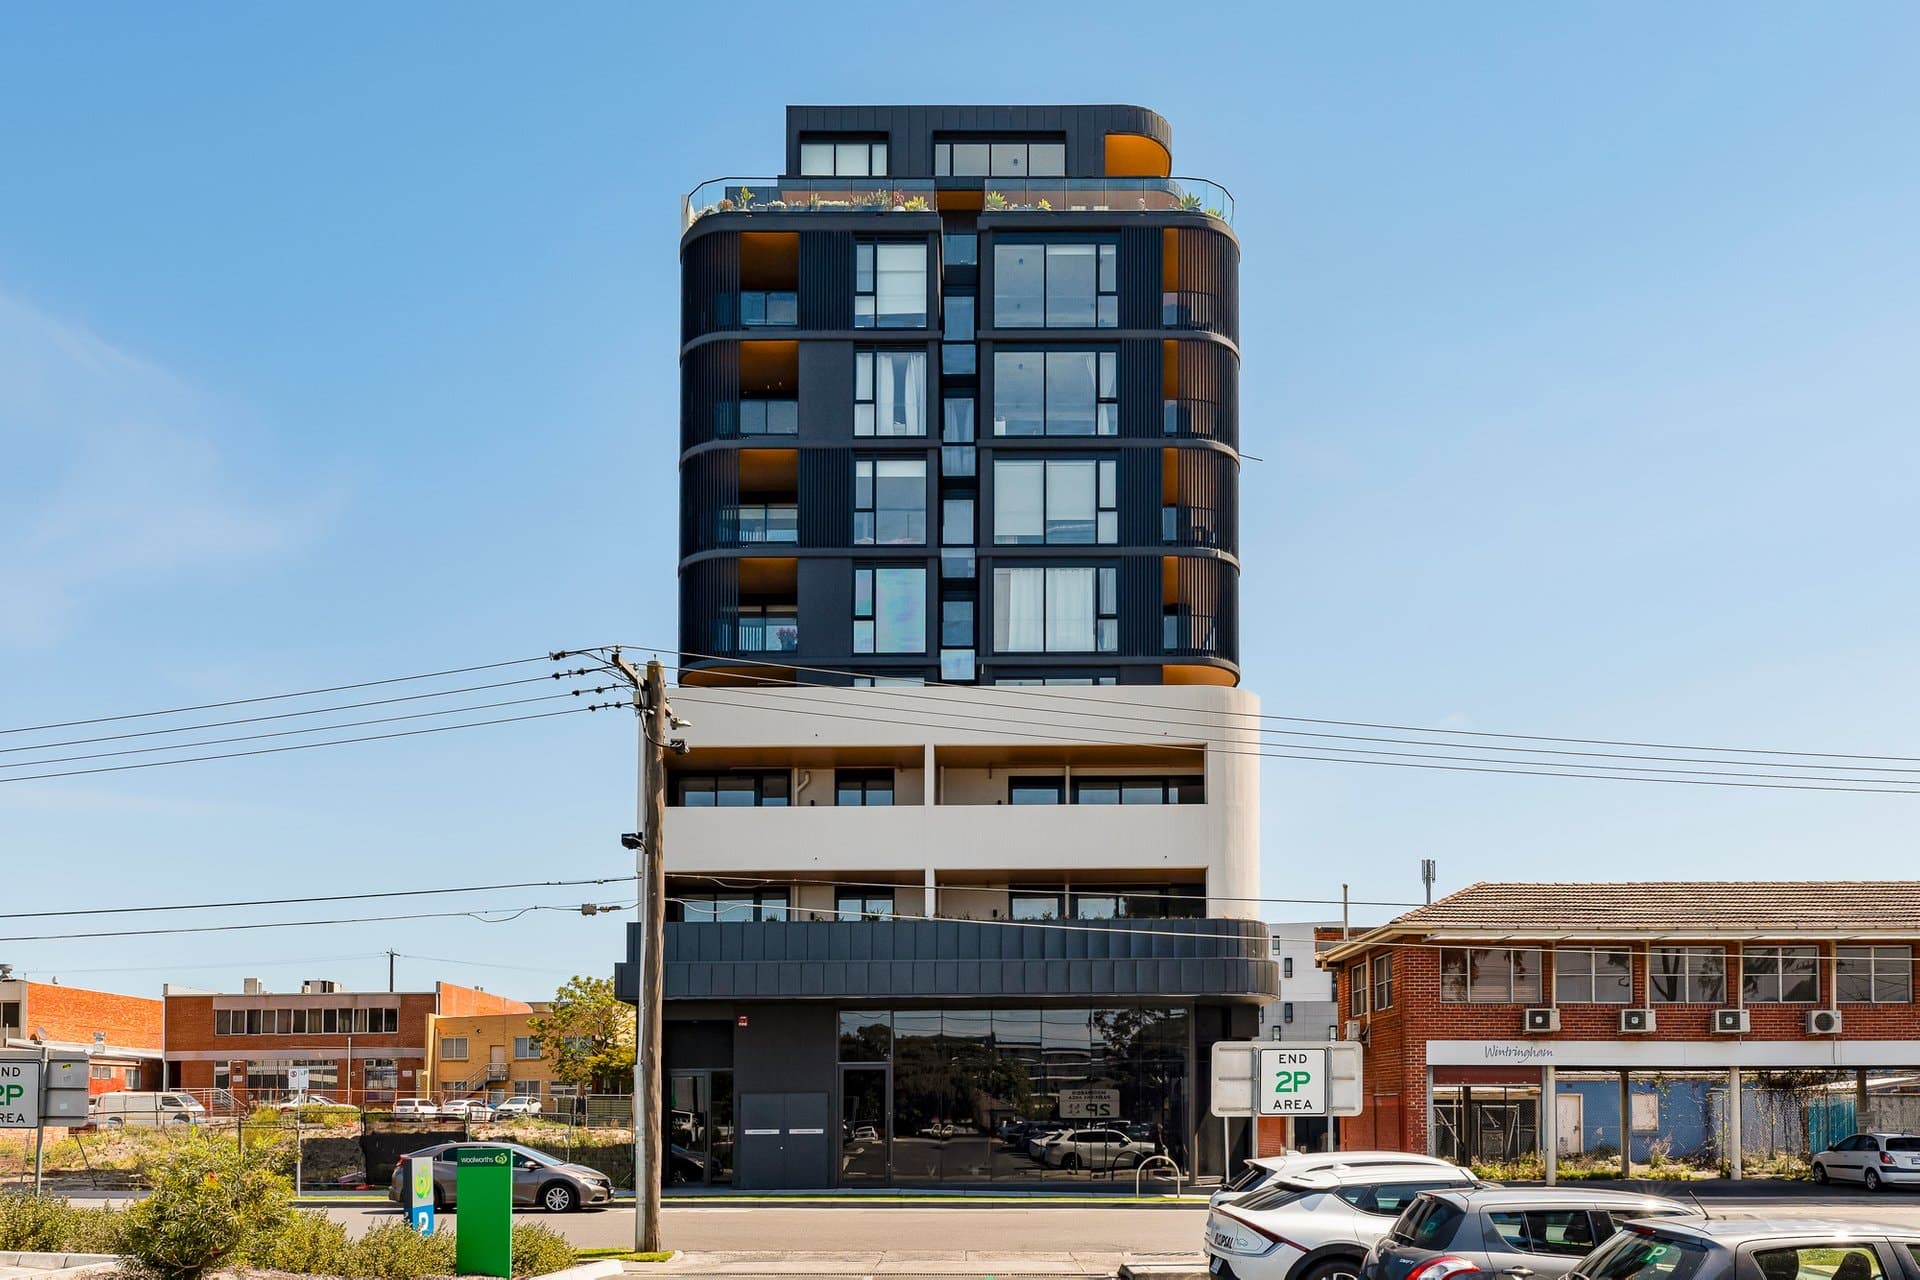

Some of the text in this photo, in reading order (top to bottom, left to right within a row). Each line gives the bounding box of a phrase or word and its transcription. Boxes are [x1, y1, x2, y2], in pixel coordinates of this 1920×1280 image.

[1279, 1054, 1308, 1064] END
[1484, 1045, 1553, 1063] Wintringham
[1, 1067, 21, 1077] ND
[1275, 1071, 1311, 1093] 2P
[0, 1084, 24, 1106] P
[1273, 1100, 1313, 1110] AREA
[0, 1113, 26, 1123] REA
[1646, 1246, 1667, 1261] P
